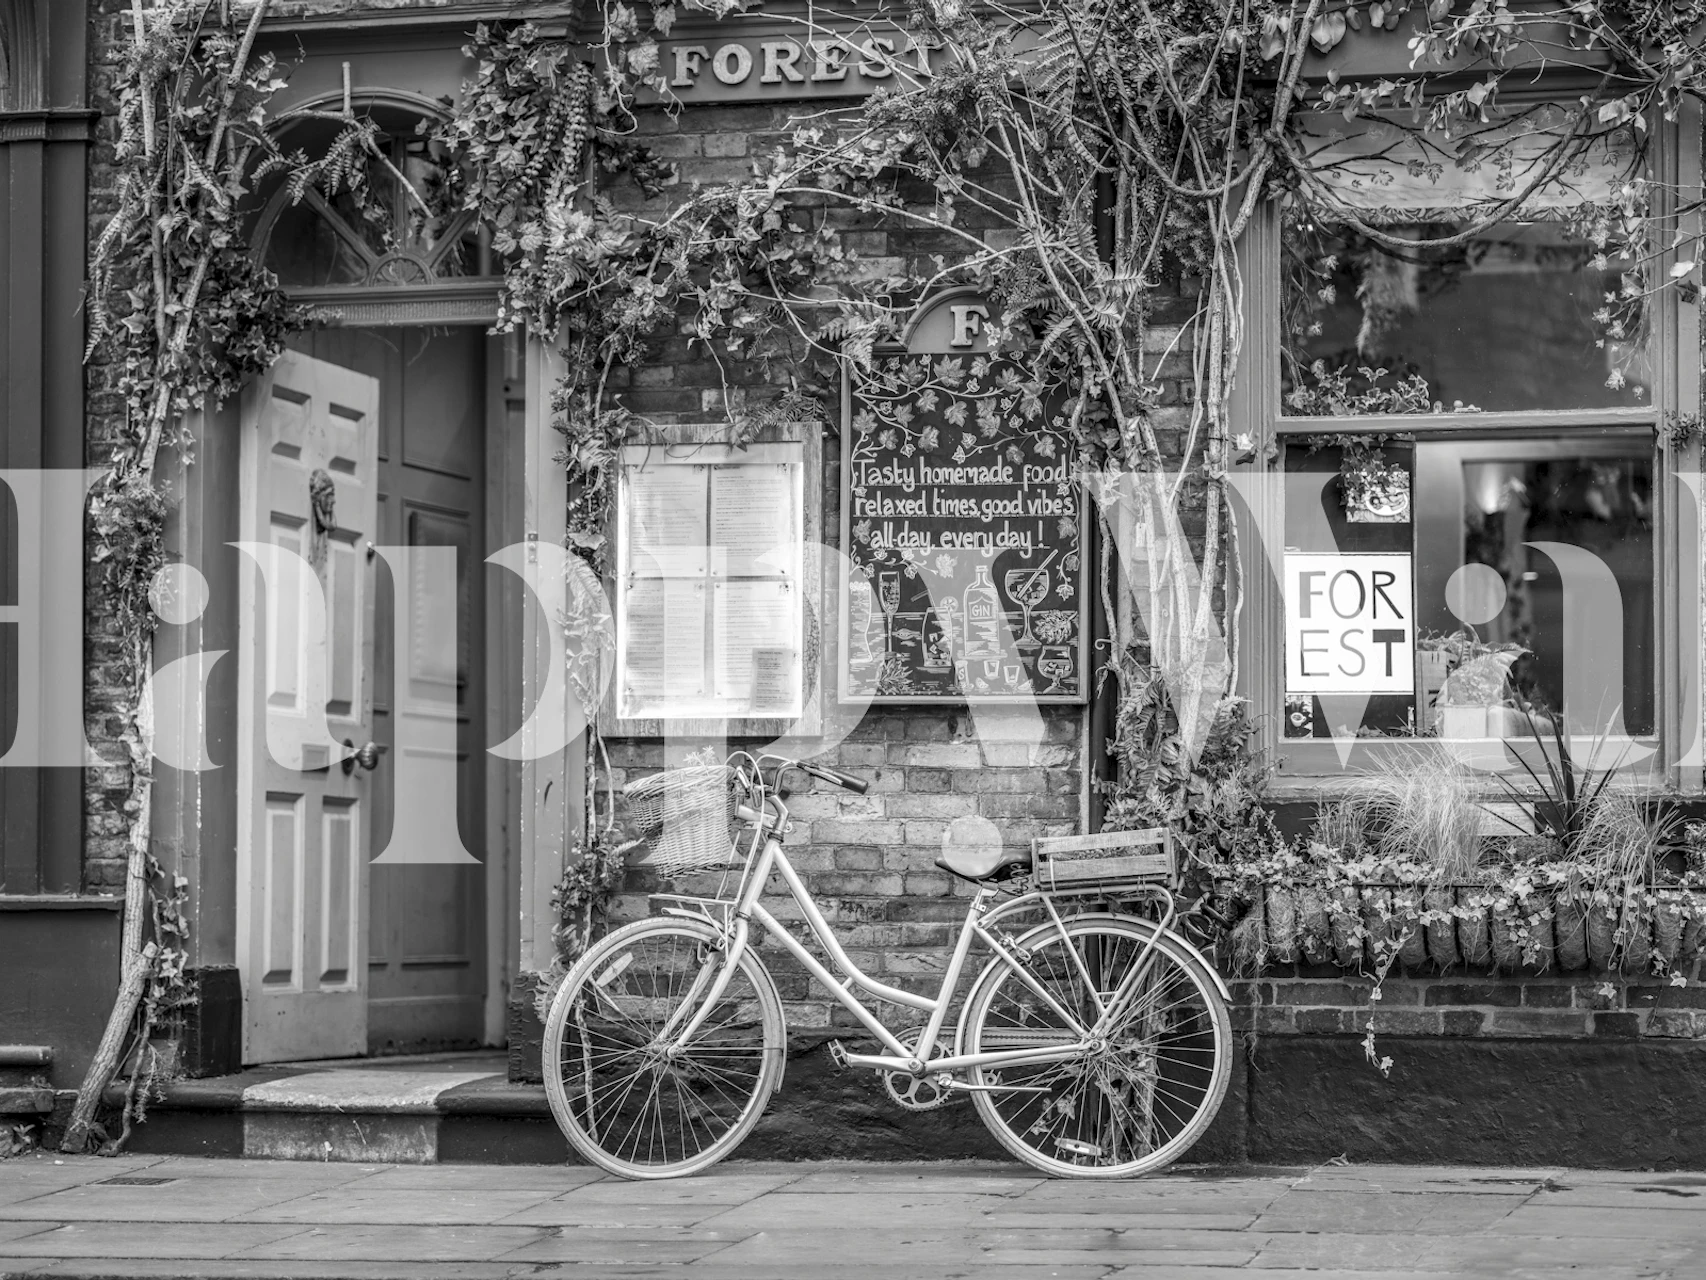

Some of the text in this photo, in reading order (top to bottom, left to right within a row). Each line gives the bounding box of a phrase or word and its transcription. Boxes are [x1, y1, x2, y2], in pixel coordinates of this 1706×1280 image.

[671, 36, 941, 87] FOREST
[950, 304, 990, 347] F
[852, 454, 1067, 492] Tasty homemade food
[854, 490, 927, 516] relaxed
[1026, 488, 1075, 516] vibes
[971, 604, 991, 617] GIN
[1299, 569, 1404, 619] FOR
[1299, 628, 1406, 677] EST
